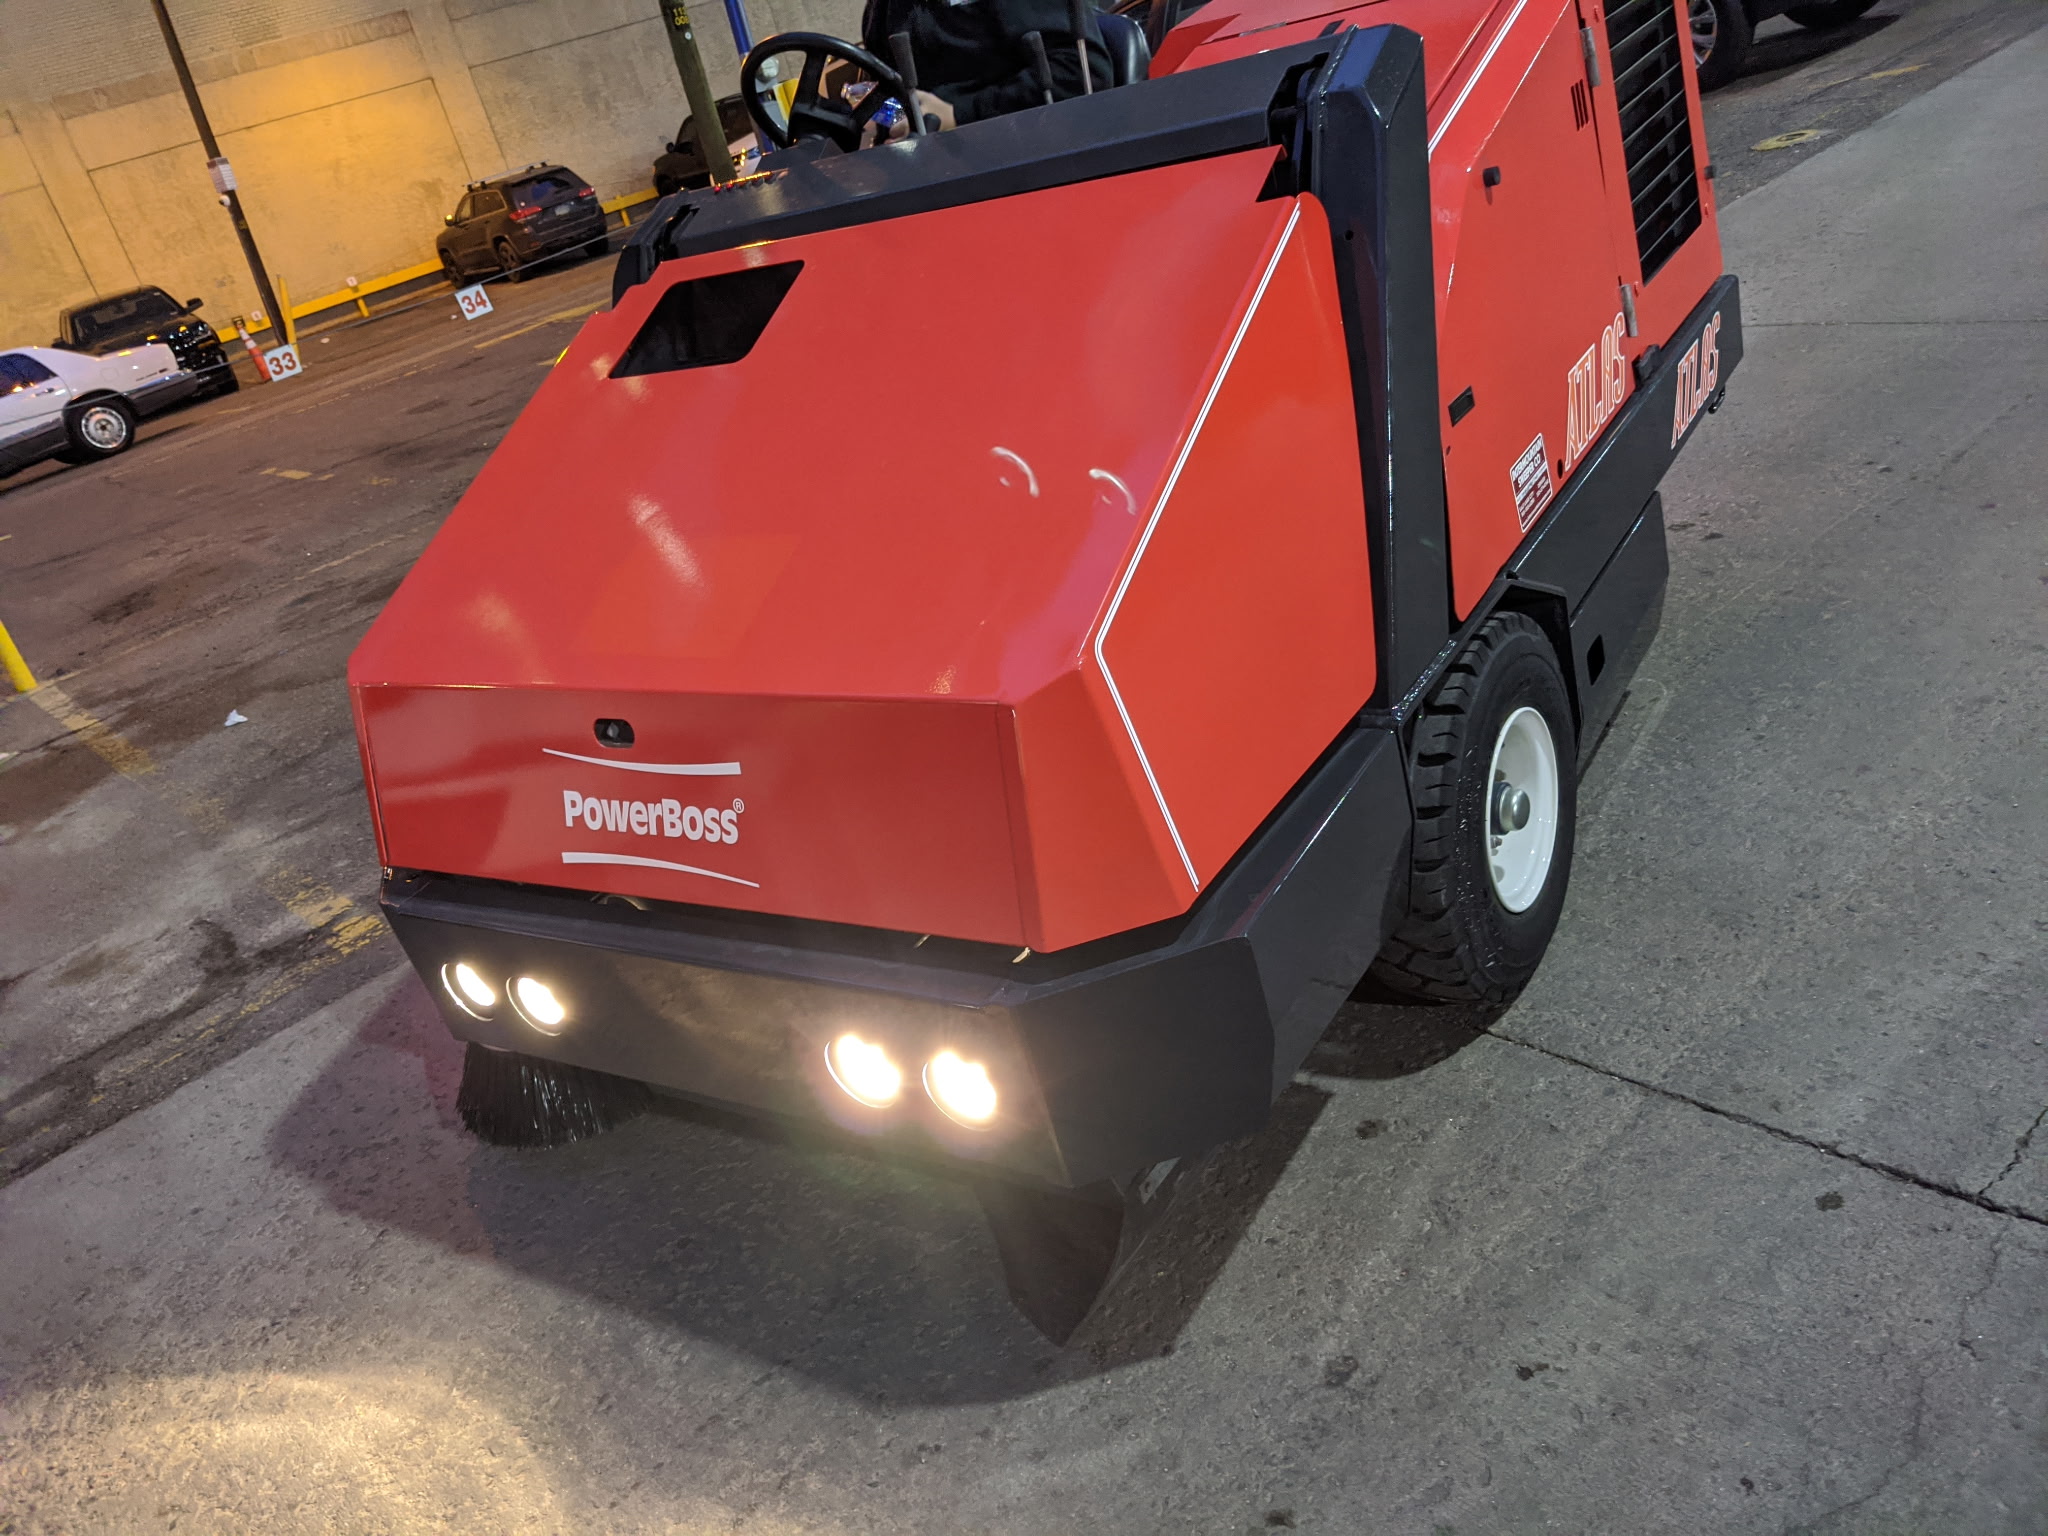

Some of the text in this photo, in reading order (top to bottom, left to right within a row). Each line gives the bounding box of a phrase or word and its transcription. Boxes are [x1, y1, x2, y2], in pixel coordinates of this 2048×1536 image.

[461, 290, 487, 314] 34
[269, 352, 296, 375] 33
[1565, 311, 1626, 472] ATLAS
[1671, 311, 1721, 450] ATLAS
